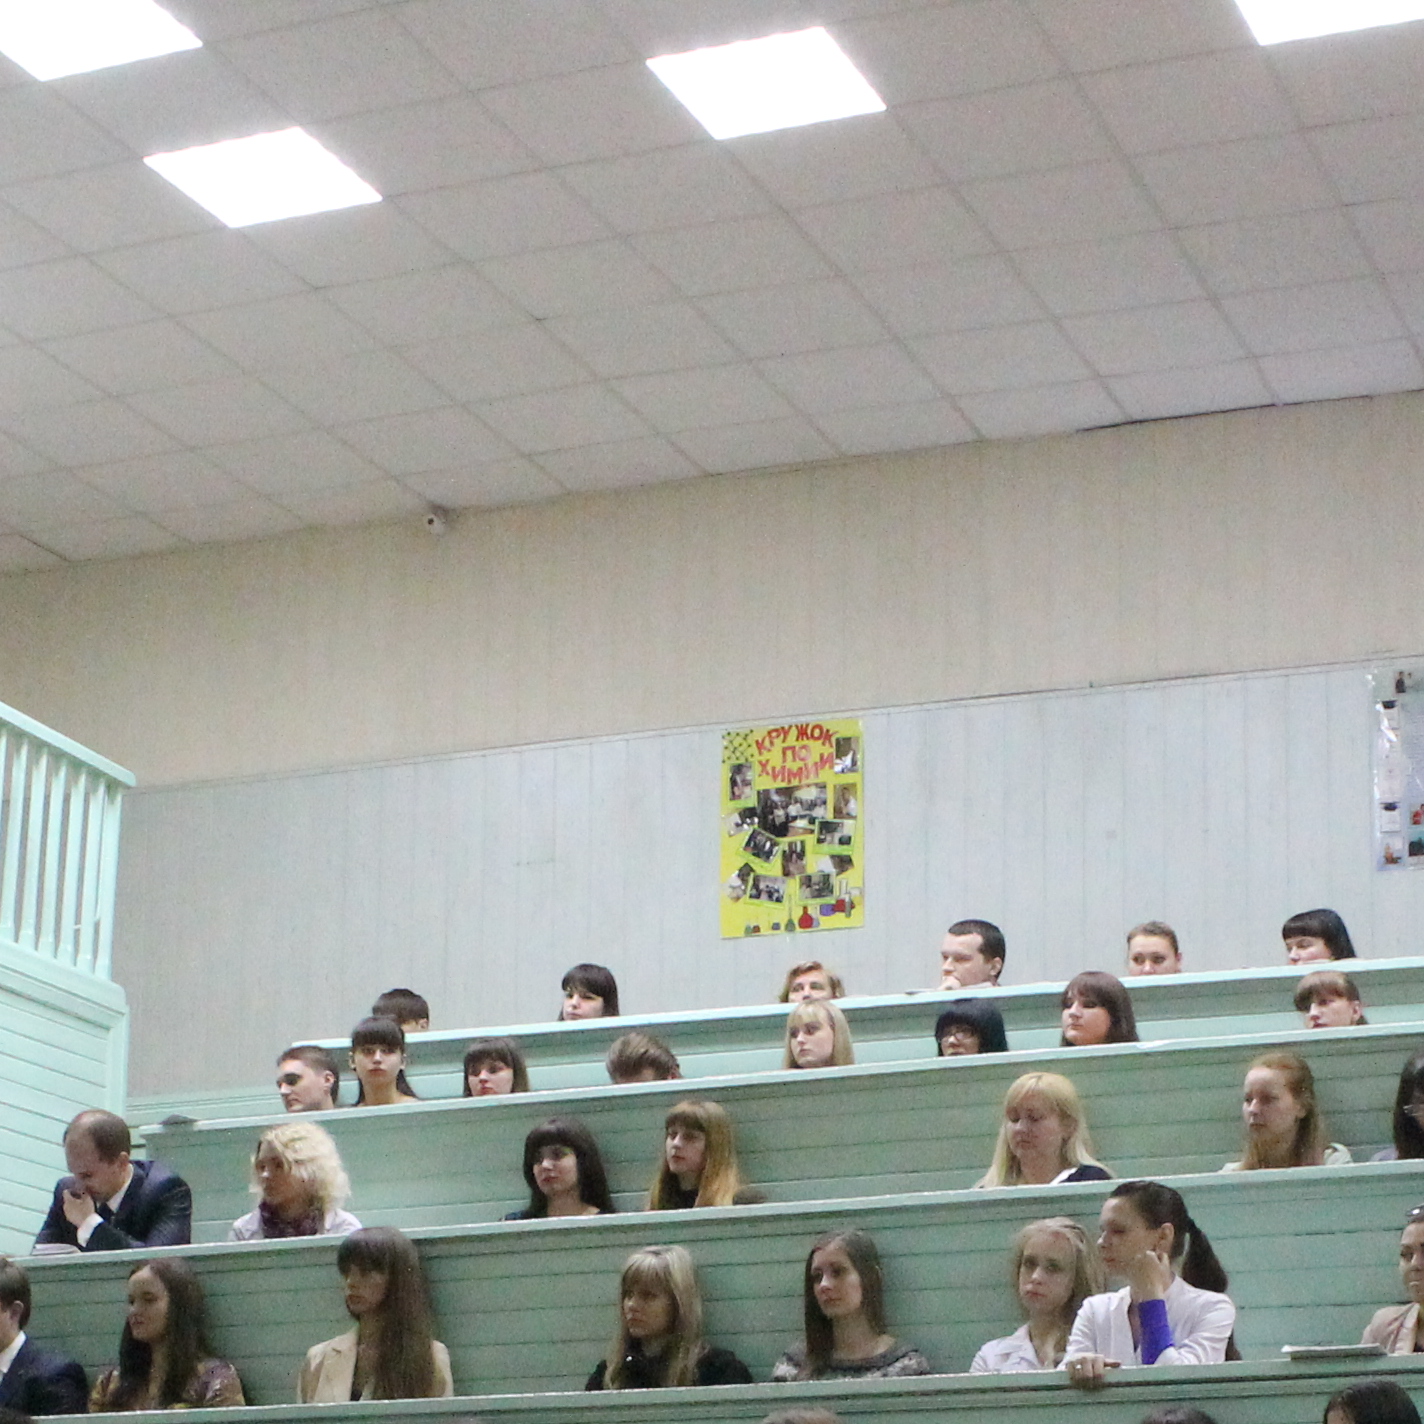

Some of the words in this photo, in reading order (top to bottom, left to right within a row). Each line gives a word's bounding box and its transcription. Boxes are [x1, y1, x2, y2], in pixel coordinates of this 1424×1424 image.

[754, 723, 839, 756] КРУЖОК
[781, 744, 812, 764] ПО
[758, 752, 835, 784] ХИМИИ
